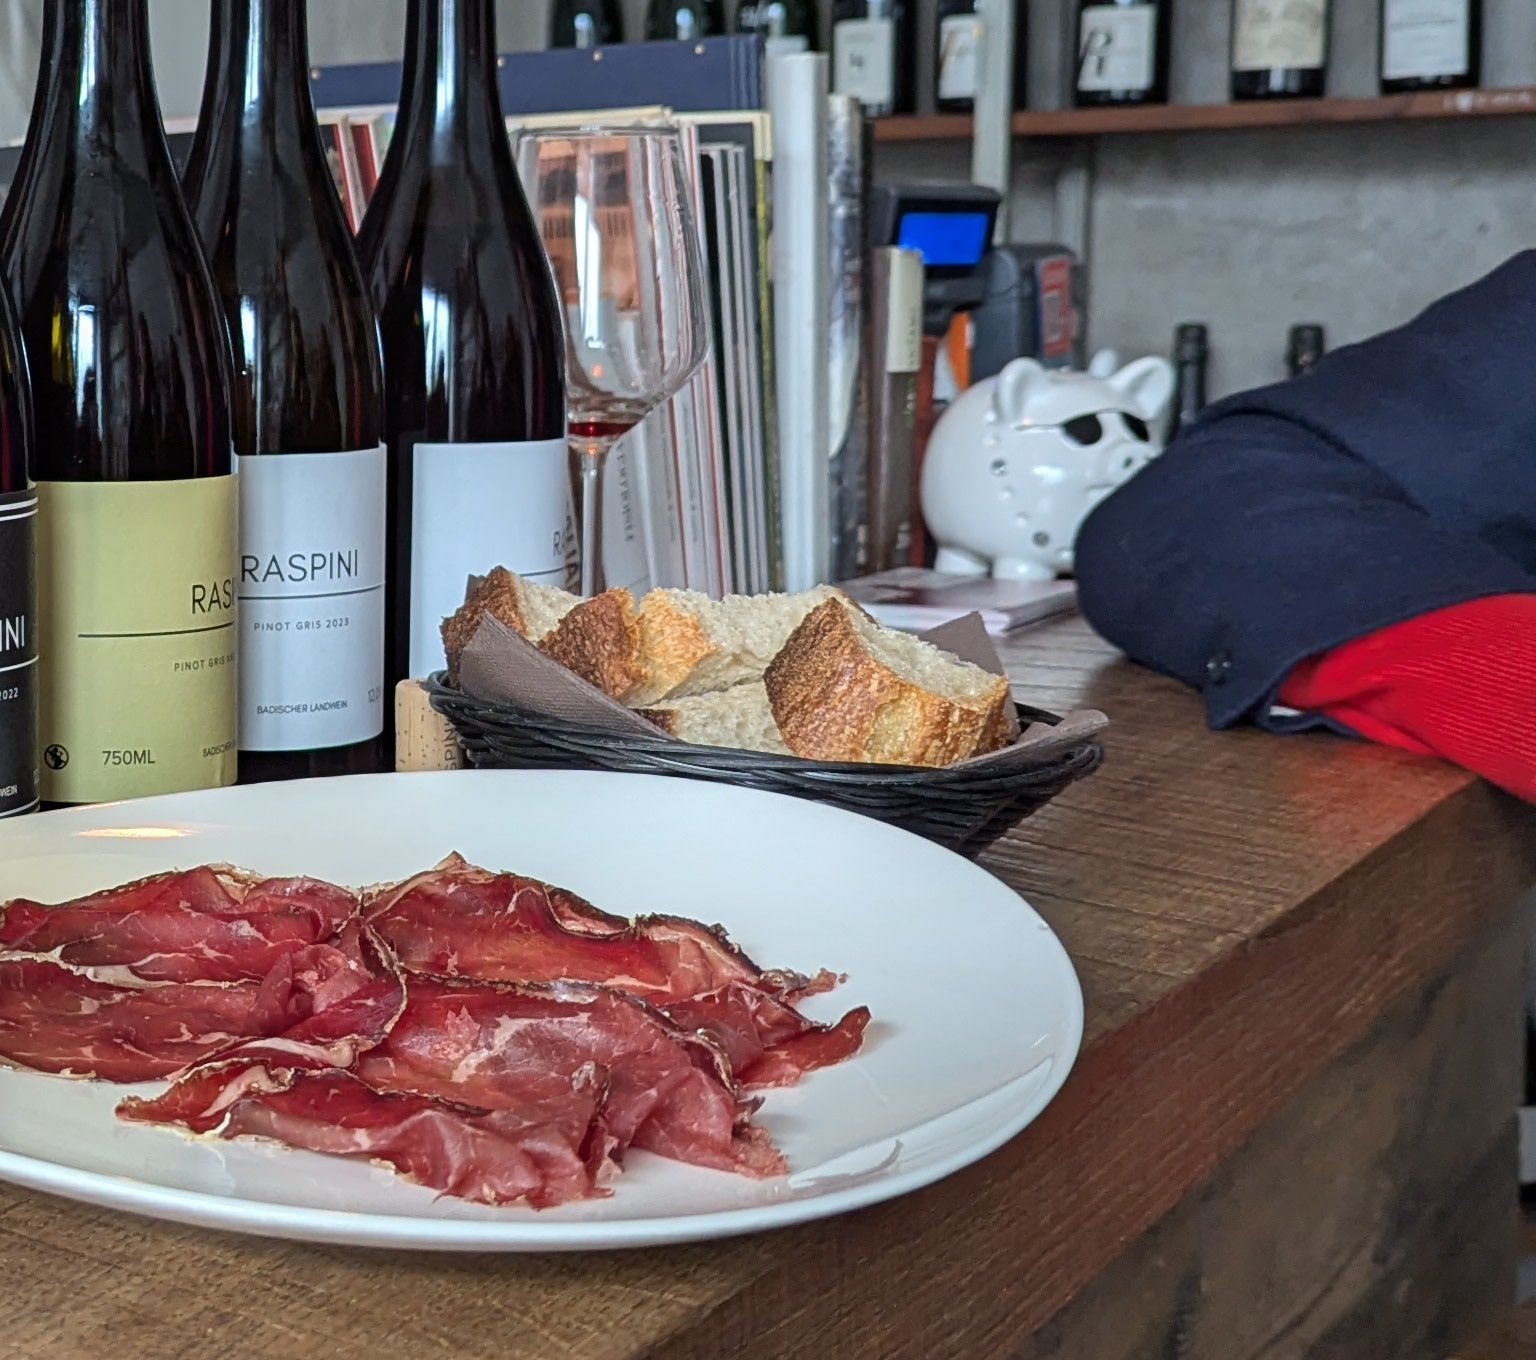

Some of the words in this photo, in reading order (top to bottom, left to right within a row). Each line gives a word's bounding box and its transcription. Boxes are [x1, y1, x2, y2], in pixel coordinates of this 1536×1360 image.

[240, 548, 359, 584] RASPINI
[253, 622, 291, 632] PINOT
[295, 620, 322, 631] GRIS
[325, 618, 350, 629] 2023
[174, 659, 206, 672] PINOT
[256, 703, 309, 715] BADISCHER
[309, 700, 348, 713] LANDWEIN
[101, 750, 156, 766] 750ML
